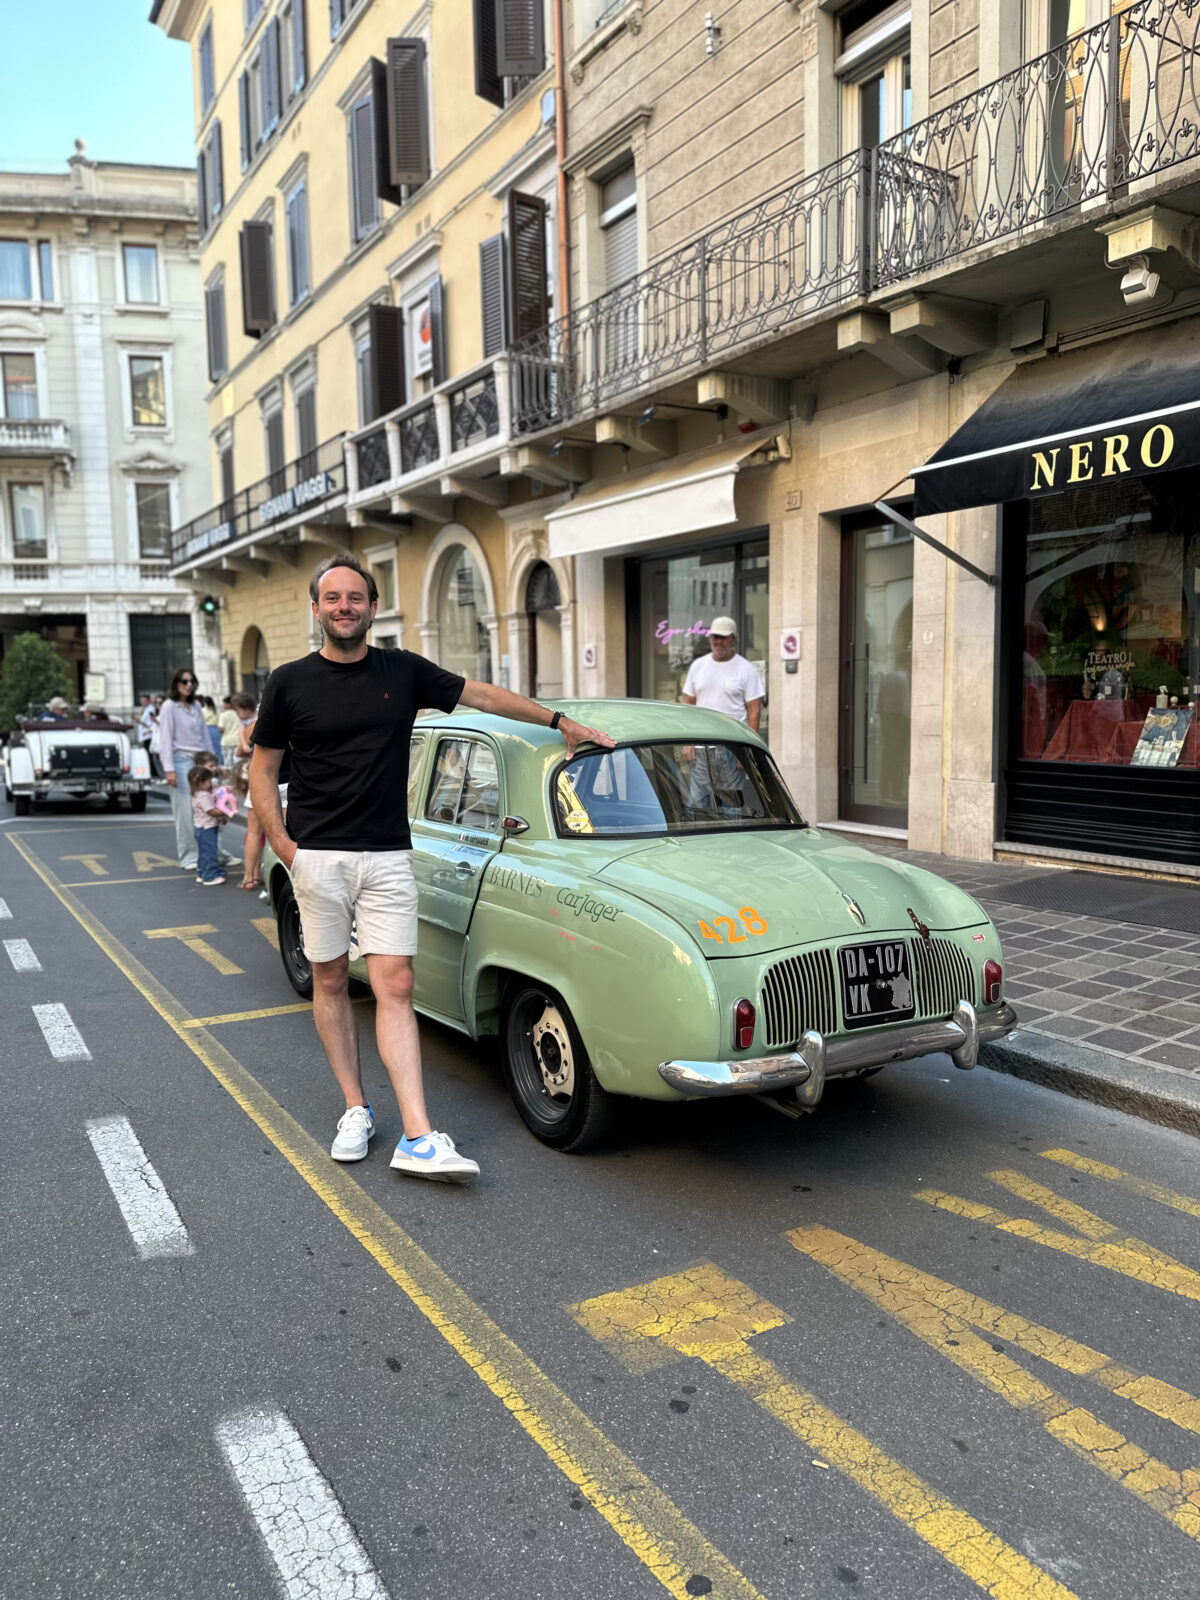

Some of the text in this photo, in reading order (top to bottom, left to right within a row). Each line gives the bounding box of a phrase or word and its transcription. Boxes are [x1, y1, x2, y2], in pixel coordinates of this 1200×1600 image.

[1030, 424, 1174, 491] NERO
[294, 473, 327, 507] VIAGGI
[1088, 651, 1127, 665] TEATRO
[488, 865, 544, 898] BARNES
[556, 887, 624, 923] CarJager
[697, 906, 769, 944] 428
[845, 944, 905, 979] DA-107
[849, 983, 872, 1014] VK
